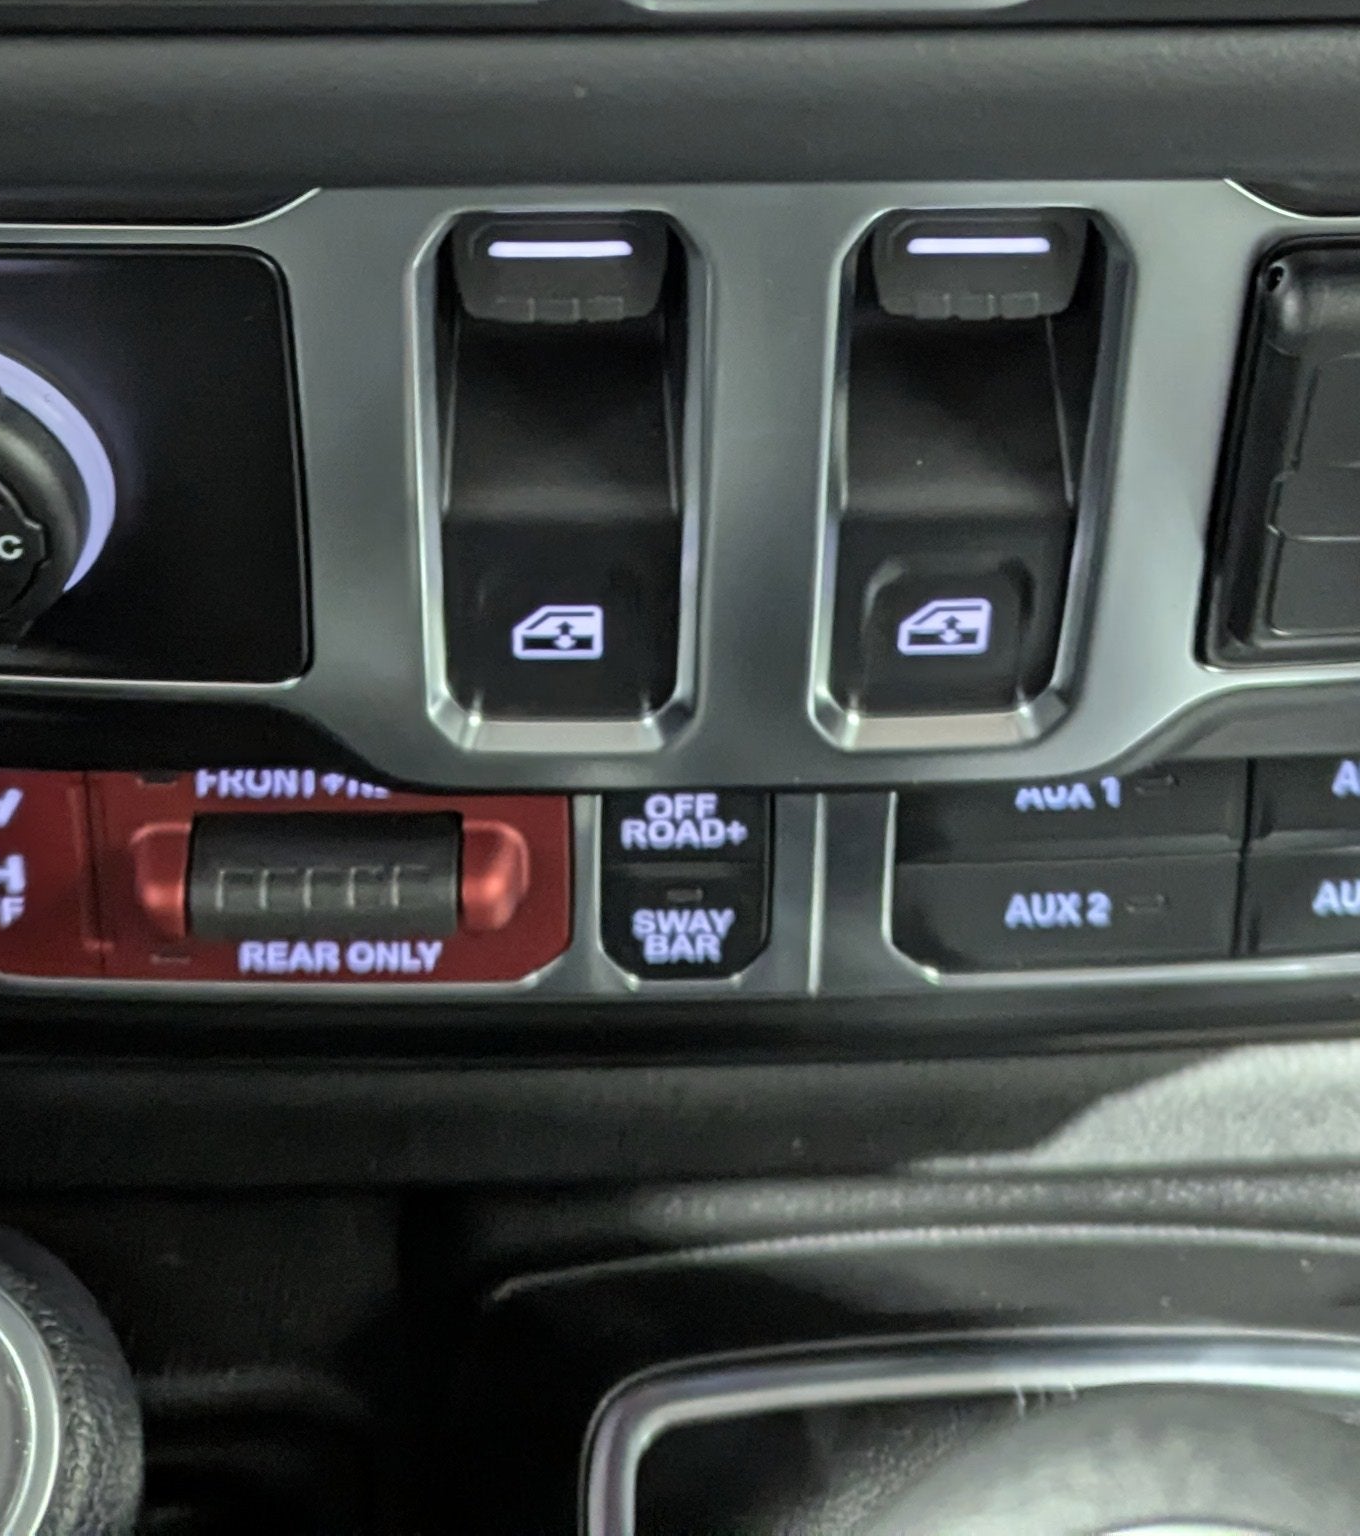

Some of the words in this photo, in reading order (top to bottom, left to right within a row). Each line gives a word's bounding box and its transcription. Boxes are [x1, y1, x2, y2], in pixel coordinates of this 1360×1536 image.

[644, 792, 718, 820] OFF
[1099, 775, 1121, 808] 1
[620, 817, 748, 850] ROAD+
[631, 908, 735, 940] SWAY
[1004, 891, 1082, 928] AUX
[1086, 891, 1112, 927] 2
[238, 940, 341, 972] REAR
[345, 940, 443, 973] ONLY
[643, 933, 722, 964] BAR
